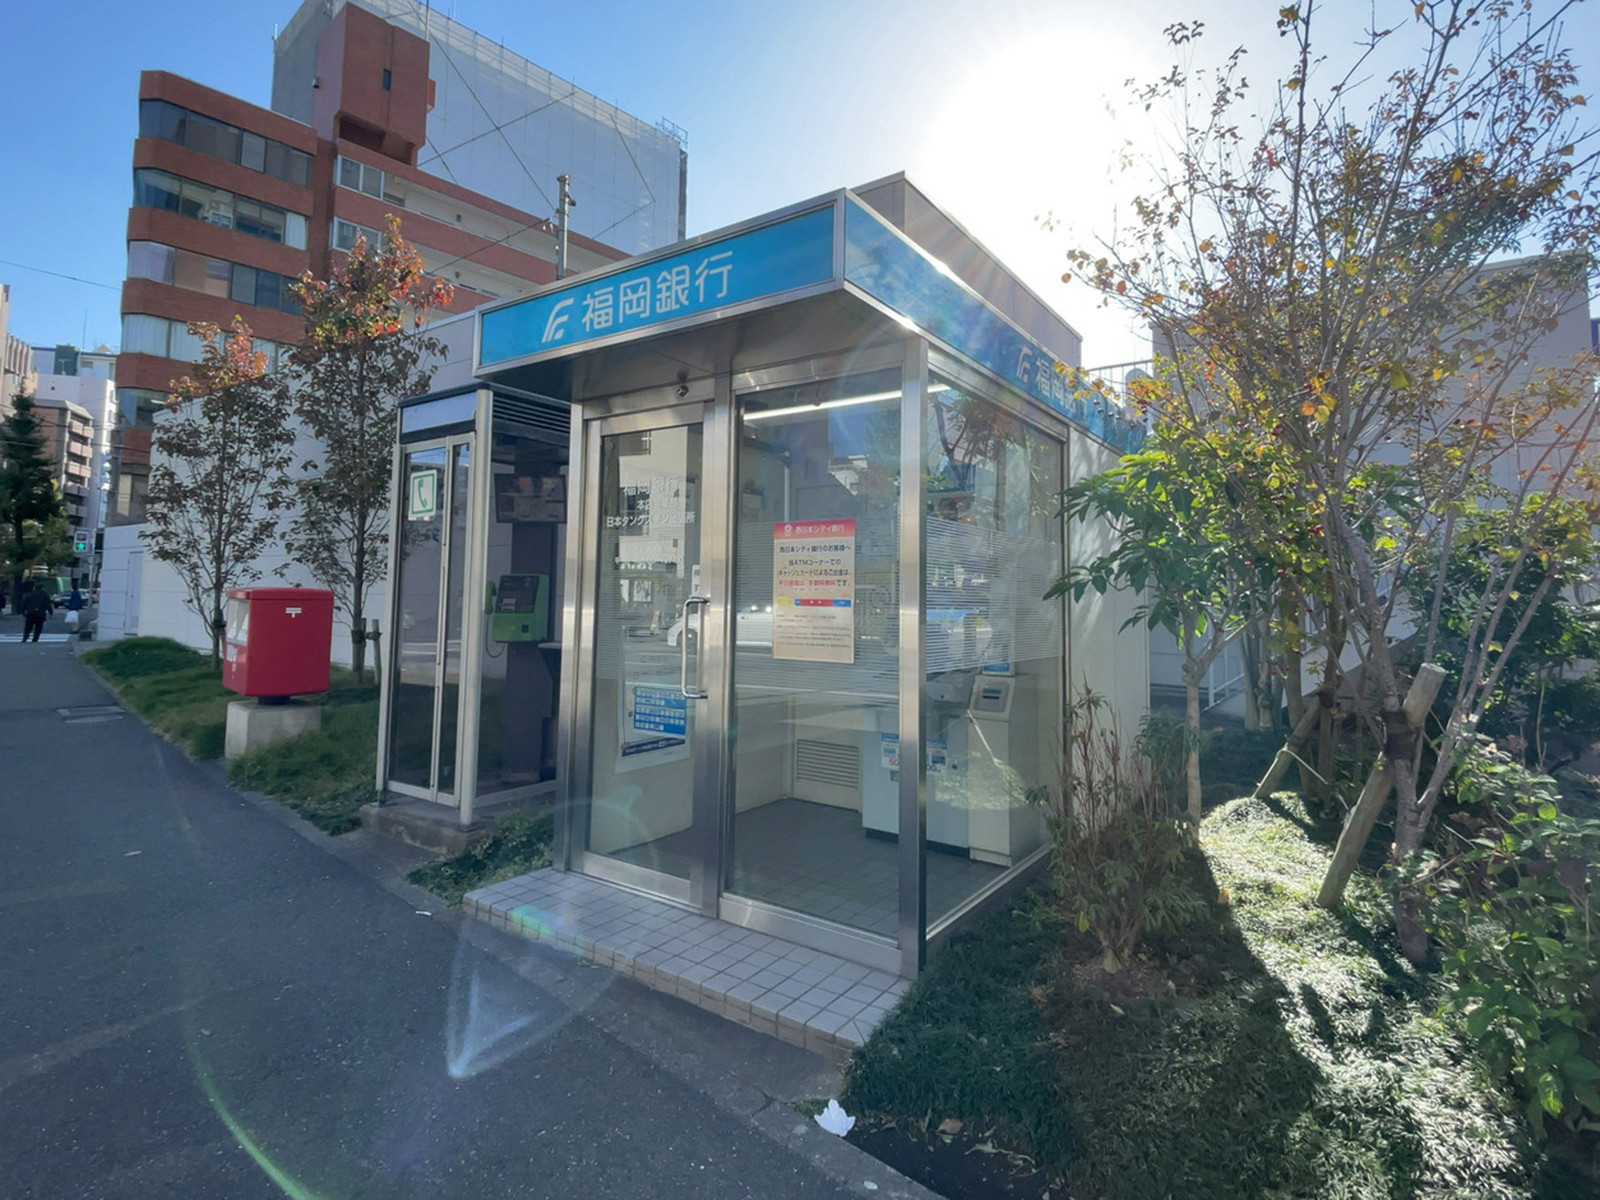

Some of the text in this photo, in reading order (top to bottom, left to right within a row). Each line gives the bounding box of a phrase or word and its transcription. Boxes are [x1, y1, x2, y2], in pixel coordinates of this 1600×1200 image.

[582, 251, 733, 332] 福岡銀行
[606, 511, 696, 527] 日本タングスン出張所
[795, 524, 845, 535] 西日本シティ銀行
[779, 544, 851, 554] 西日本シティ銀行のお客様へ
